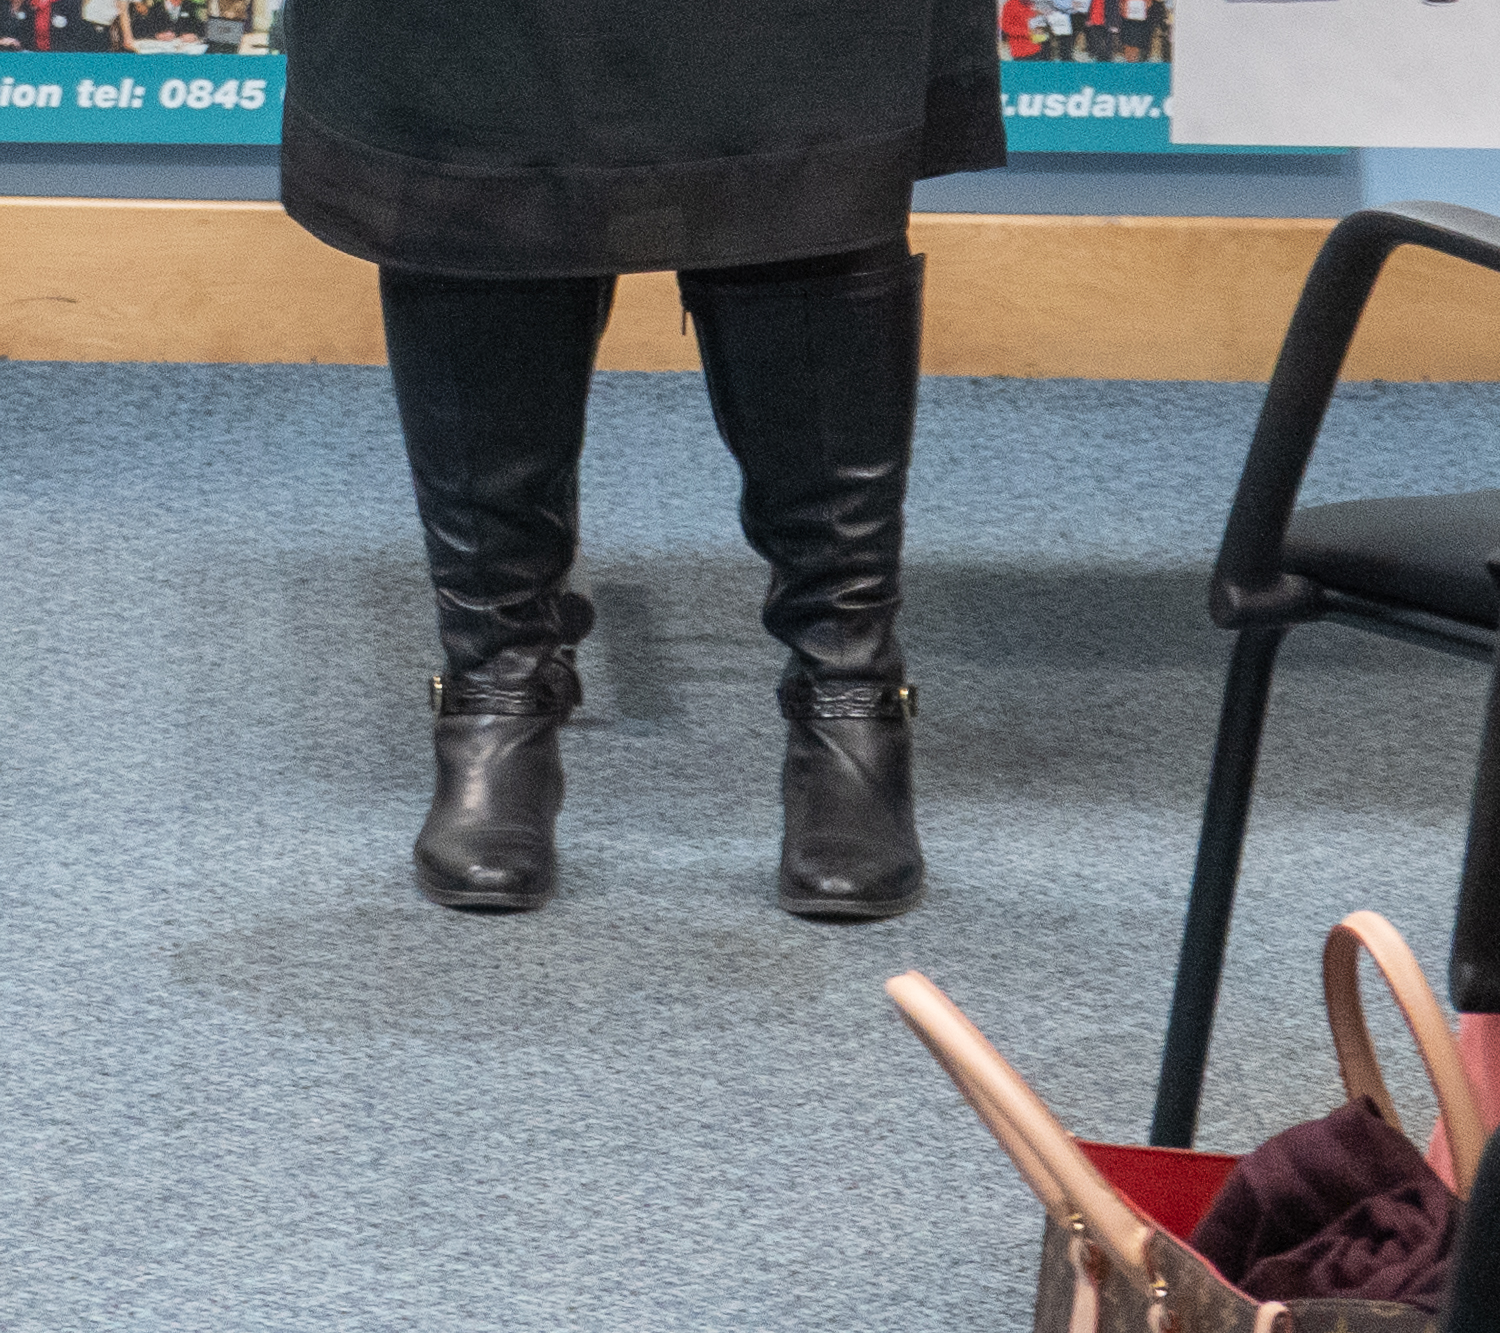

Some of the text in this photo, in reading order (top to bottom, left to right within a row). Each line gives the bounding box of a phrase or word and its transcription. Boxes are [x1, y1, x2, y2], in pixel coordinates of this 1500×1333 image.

[77, 77, 146, 109] tel:
[158, 78, 269, 111] 0845
[1000, 86, 1173, 119] .usdaw.
